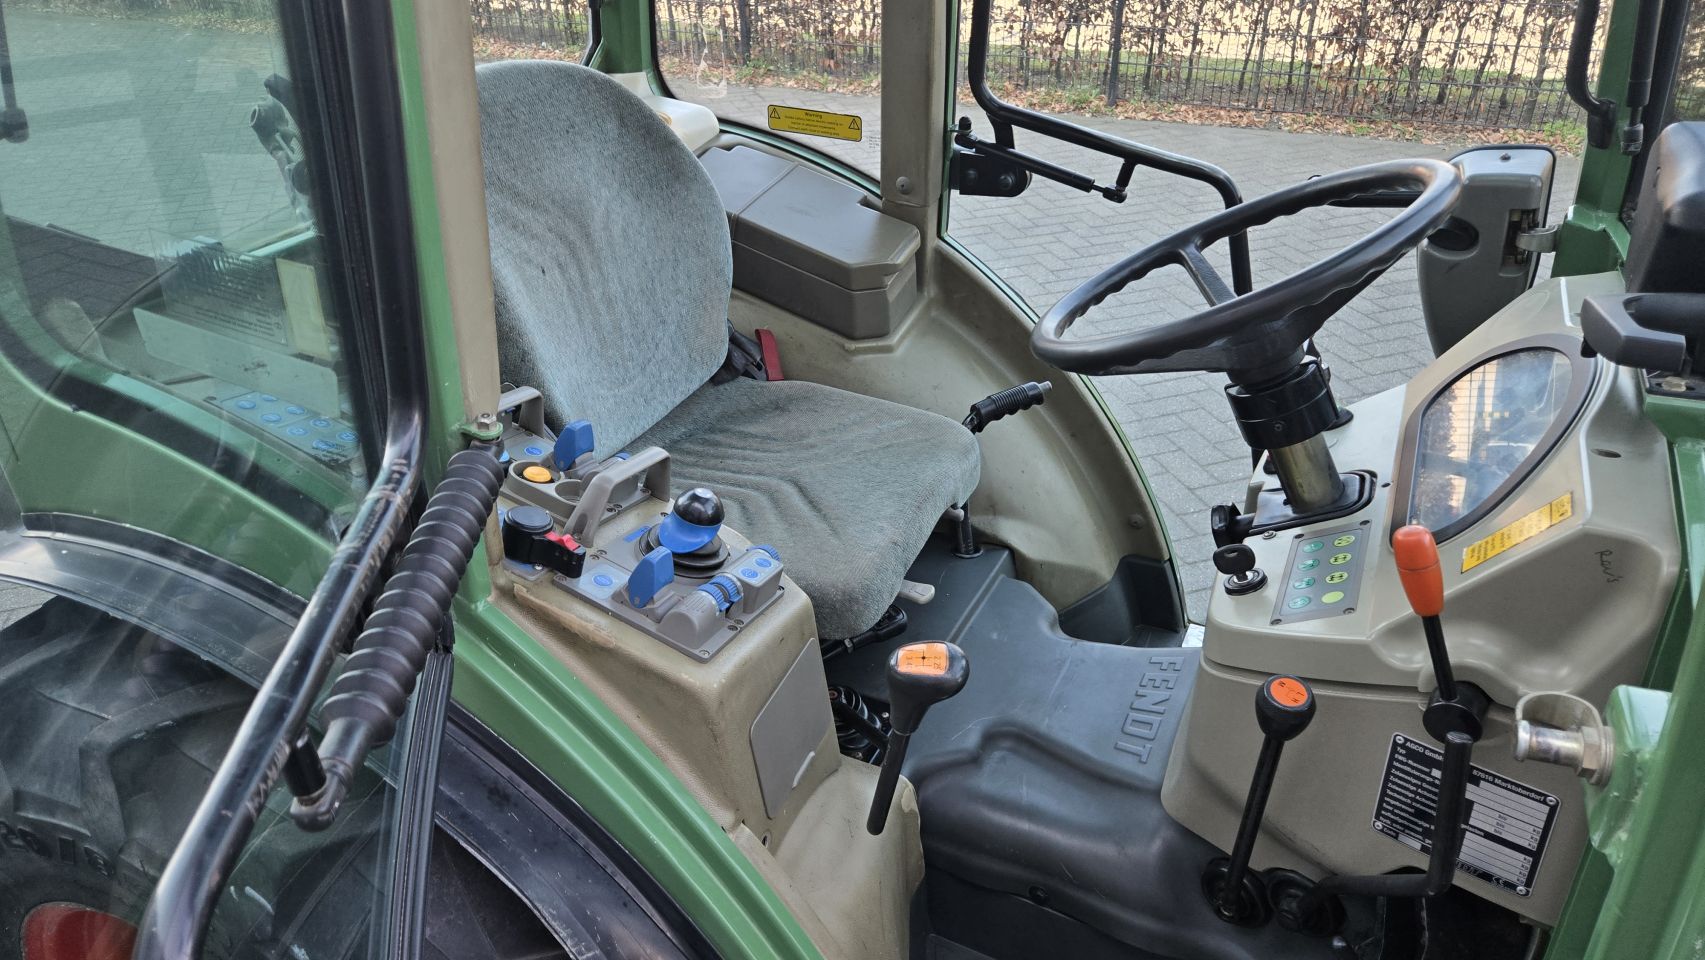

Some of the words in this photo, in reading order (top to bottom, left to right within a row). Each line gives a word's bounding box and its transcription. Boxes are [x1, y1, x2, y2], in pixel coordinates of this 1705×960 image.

[1114, 656, 1184, 764] FENDT
[1396, 746, 1406, 754] Typ
[1405, 740, 1424, 752] AGCO
[1494, 777, 1544, 802] Marktoberdorf
